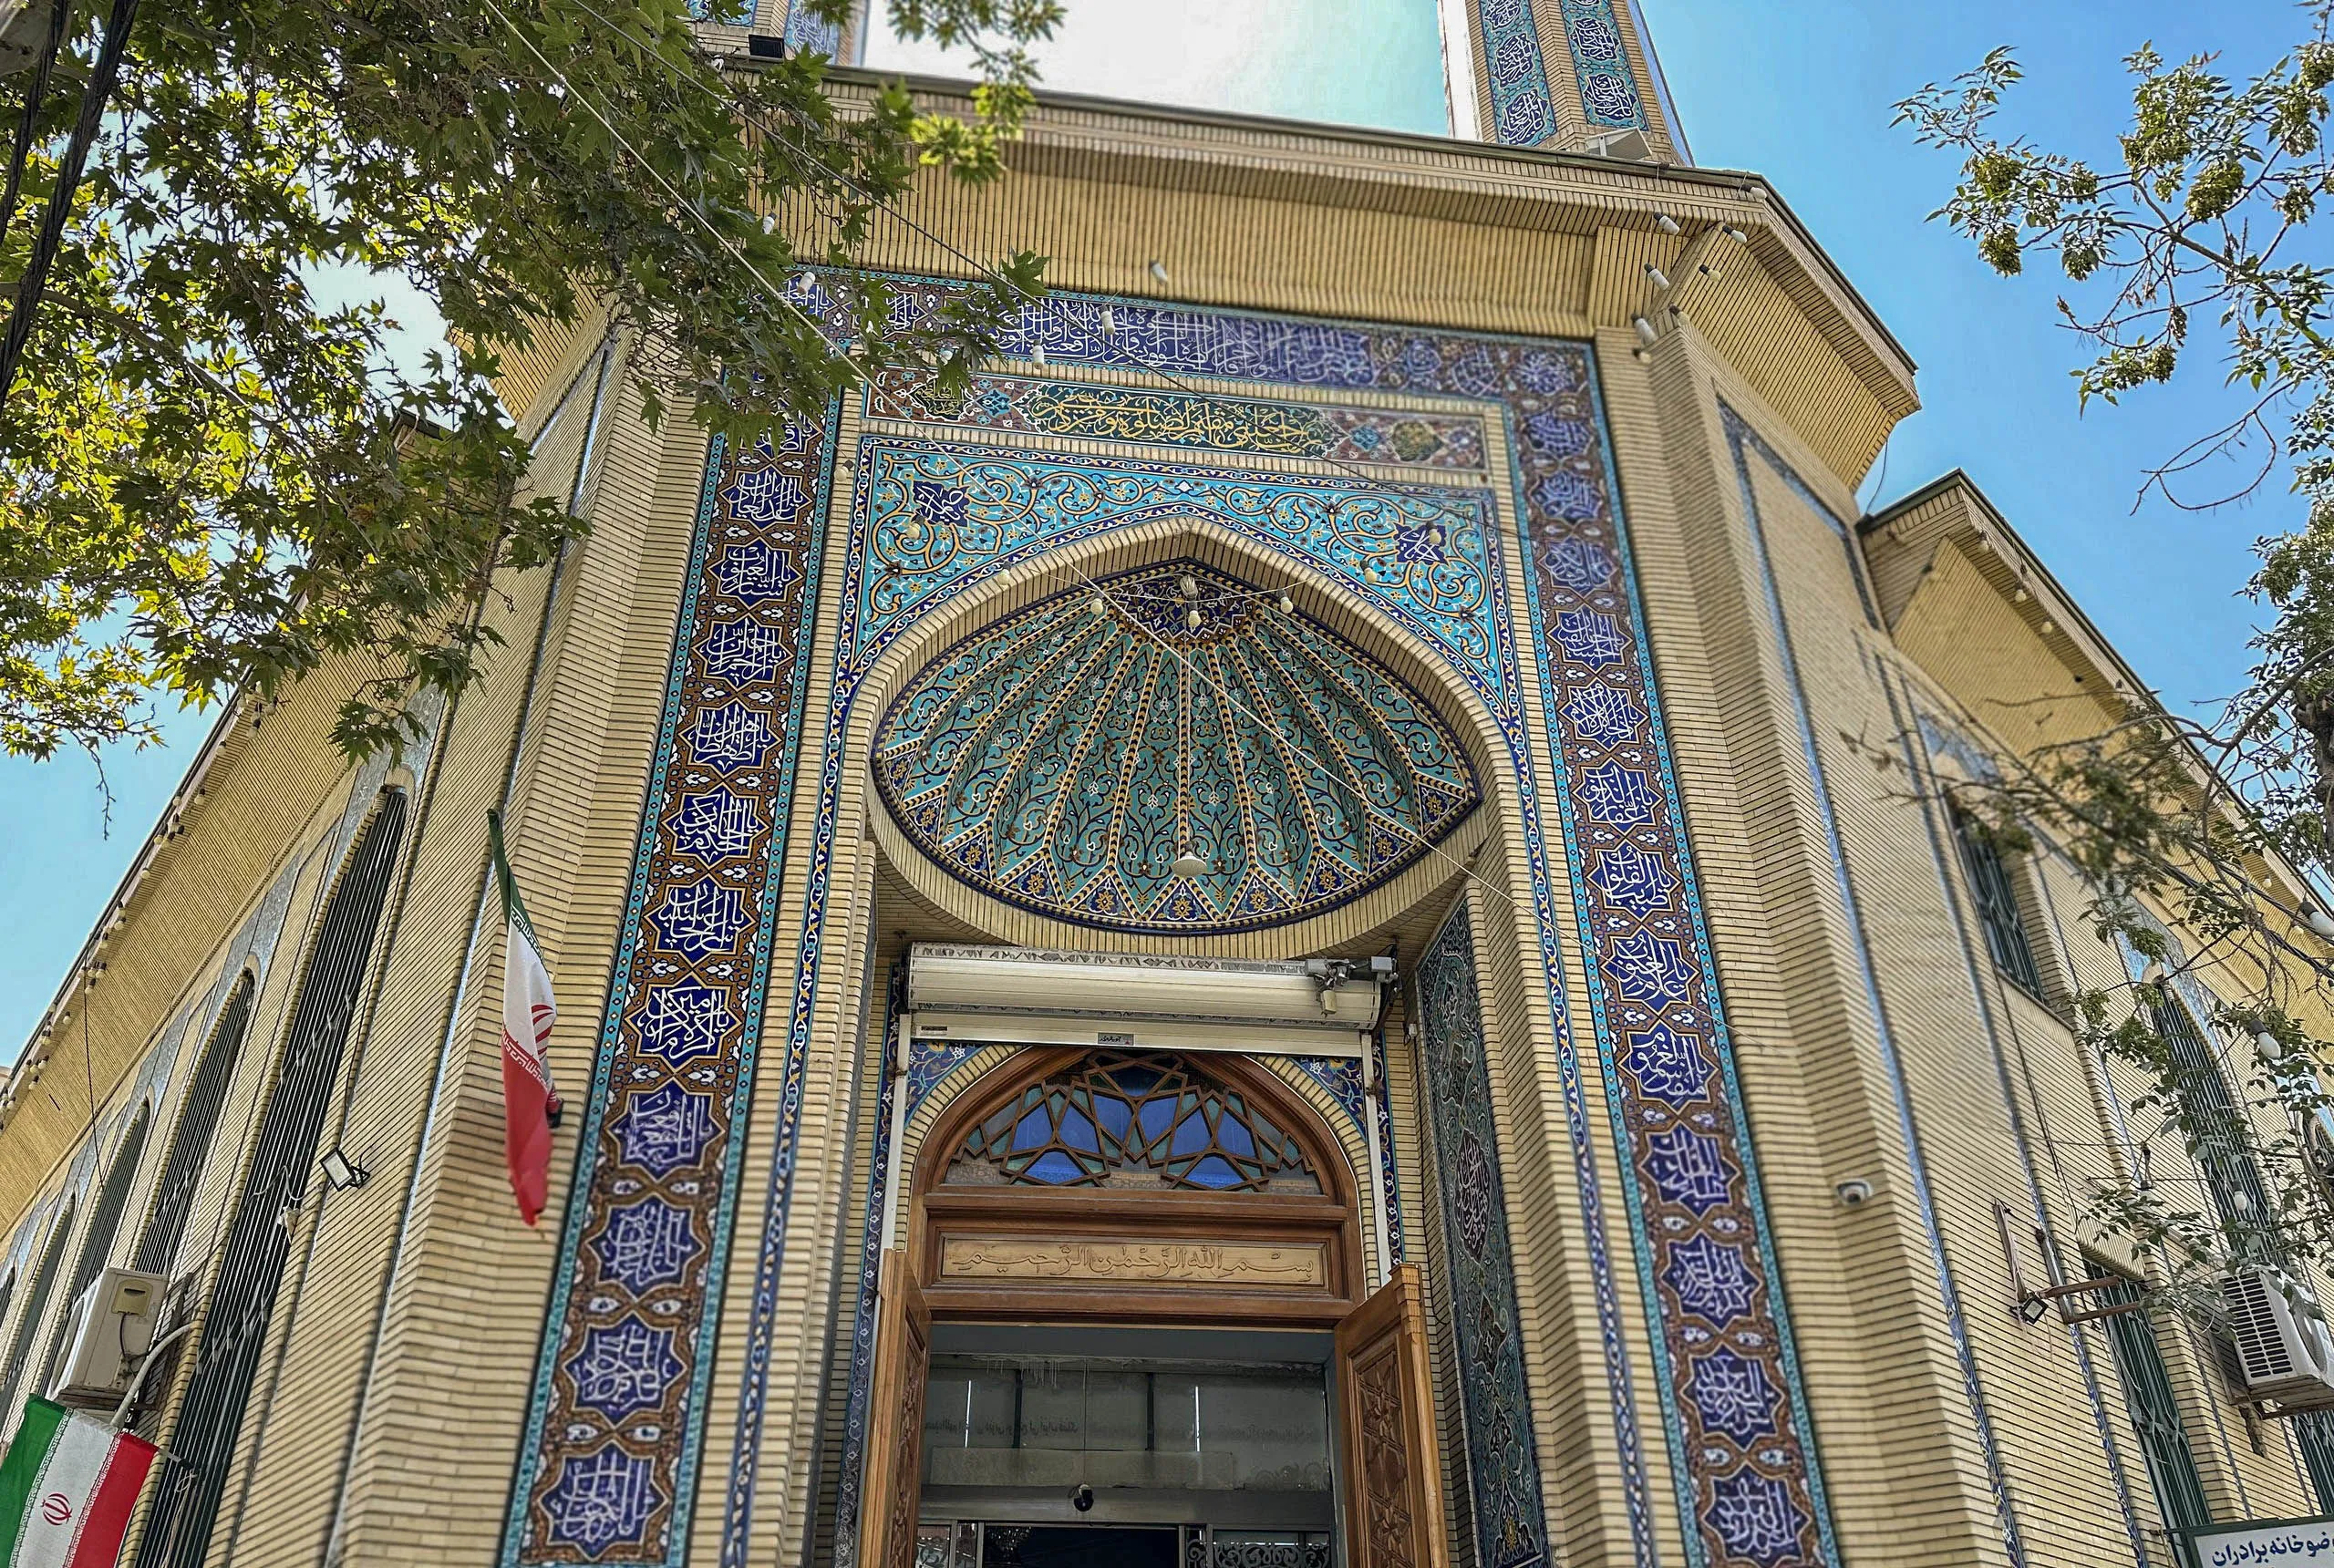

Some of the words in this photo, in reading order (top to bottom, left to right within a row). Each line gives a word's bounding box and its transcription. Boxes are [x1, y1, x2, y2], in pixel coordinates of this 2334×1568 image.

[953, 1244, 1090, 1275] الرحيم
[1090, 1246, 1188, 1278] الرحمن
[1189, 1245, 1224, 1276] الله
[1222, 1252, 1315, 1282] بسم
[2211, 1540, 2268, 1567] برادران
[2269, 1531, 2334, 1558] ضوخانه
